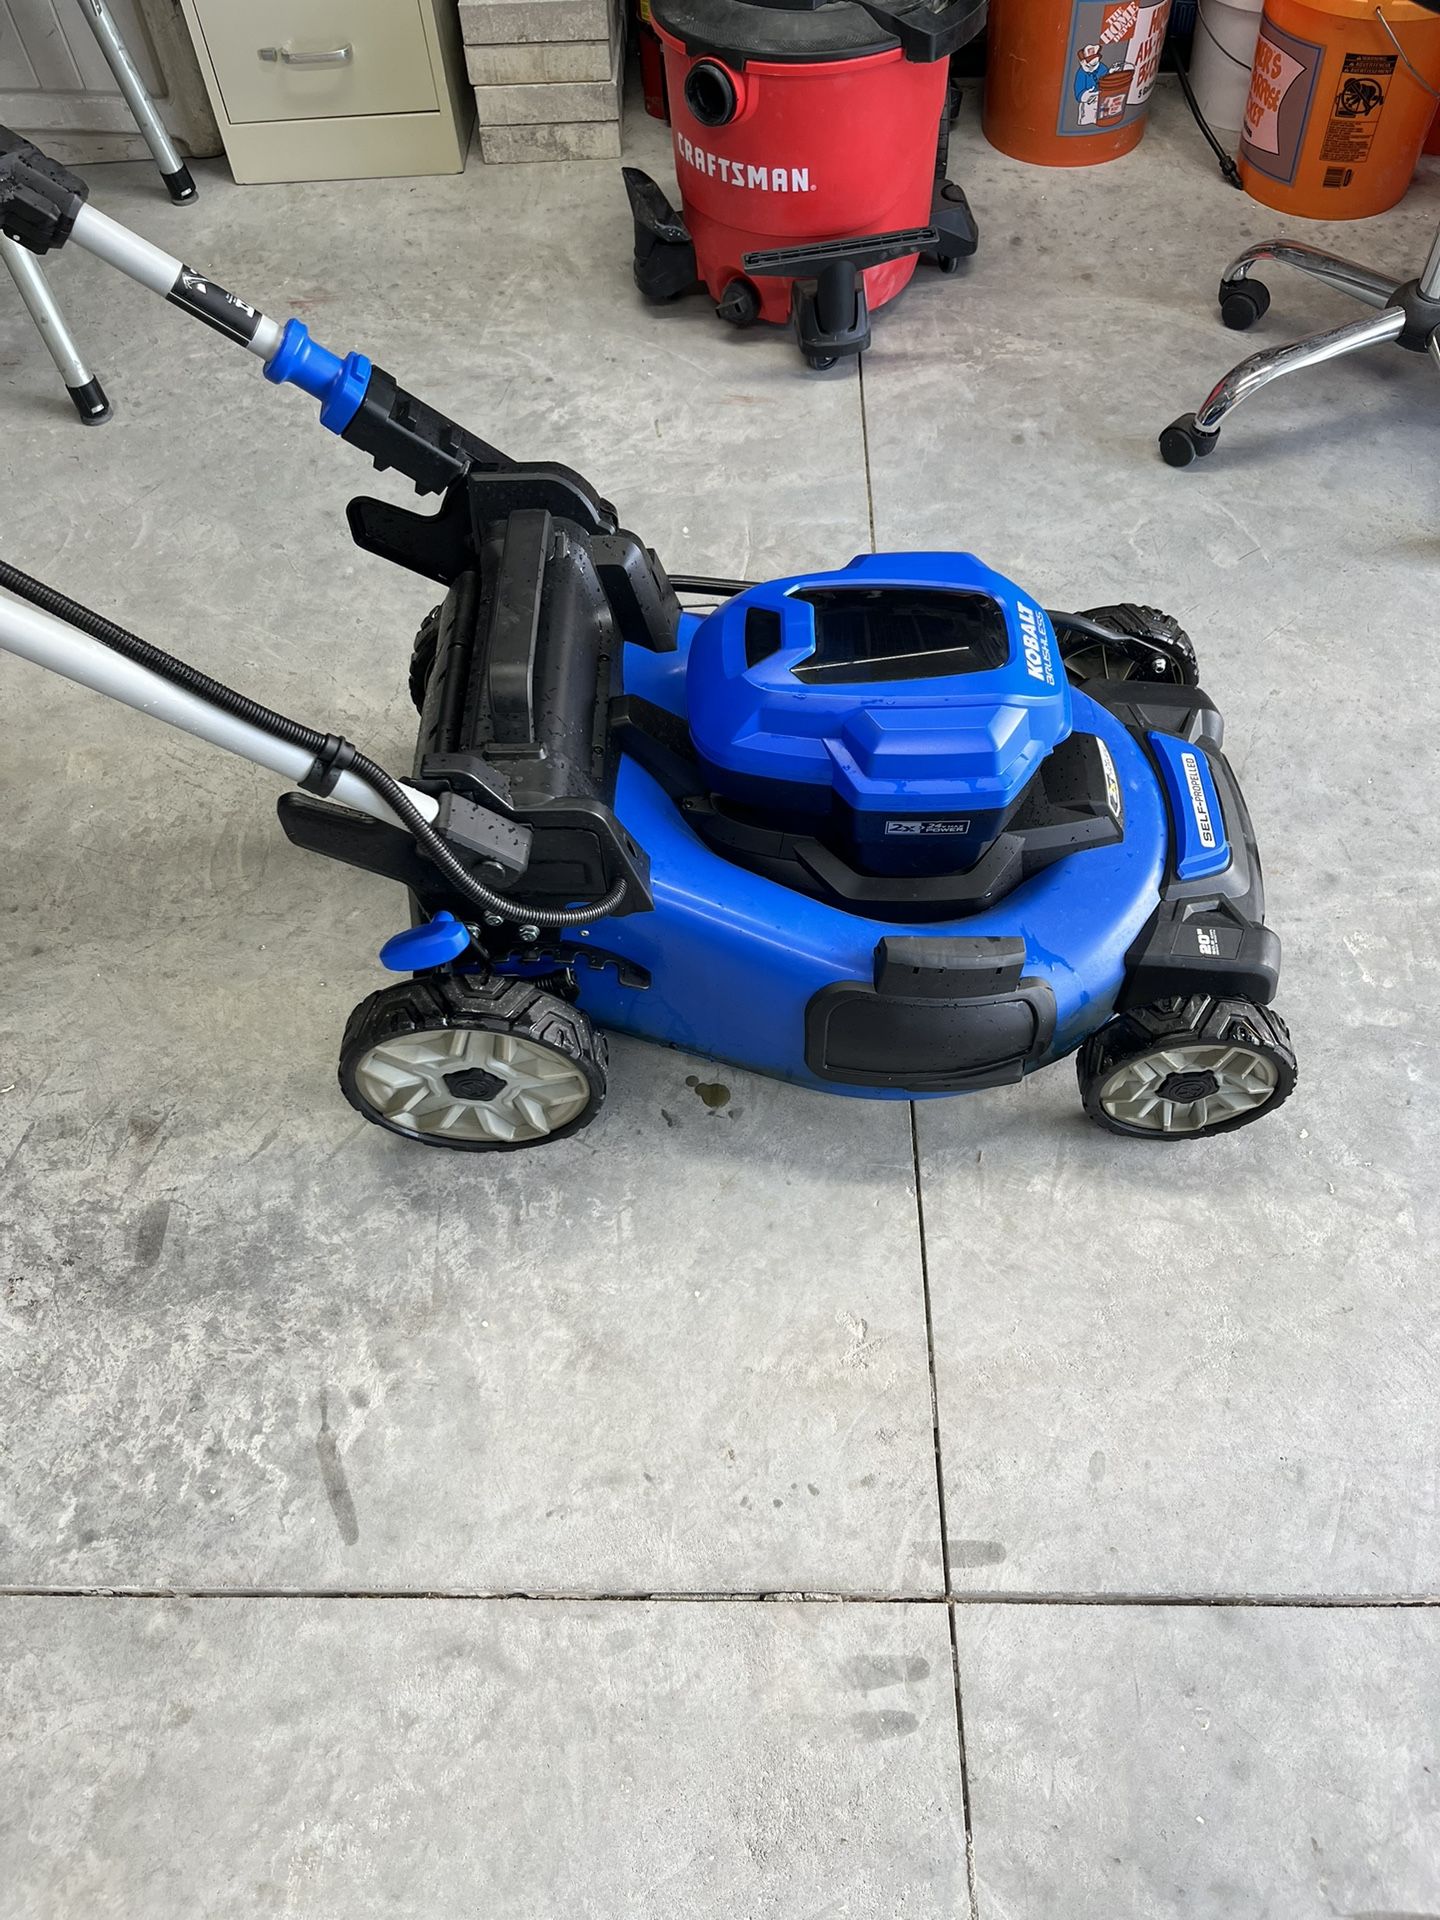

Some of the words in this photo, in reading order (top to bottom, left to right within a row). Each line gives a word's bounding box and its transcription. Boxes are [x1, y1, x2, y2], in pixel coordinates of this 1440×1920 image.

[1100, 1, 1139, 44] HOME
[1106, 6, 1123, 24] THE
[1114, 14, 1136, 42] DEPOT
[678, 132, 809, 192] CRAFTSMAN
[1016, 600, 1045, 681] KOBALT
[1035, 610, 1055, 686] BRUSHLESS
[1185, 757, 1213, 841] SELF-PROPELLED
